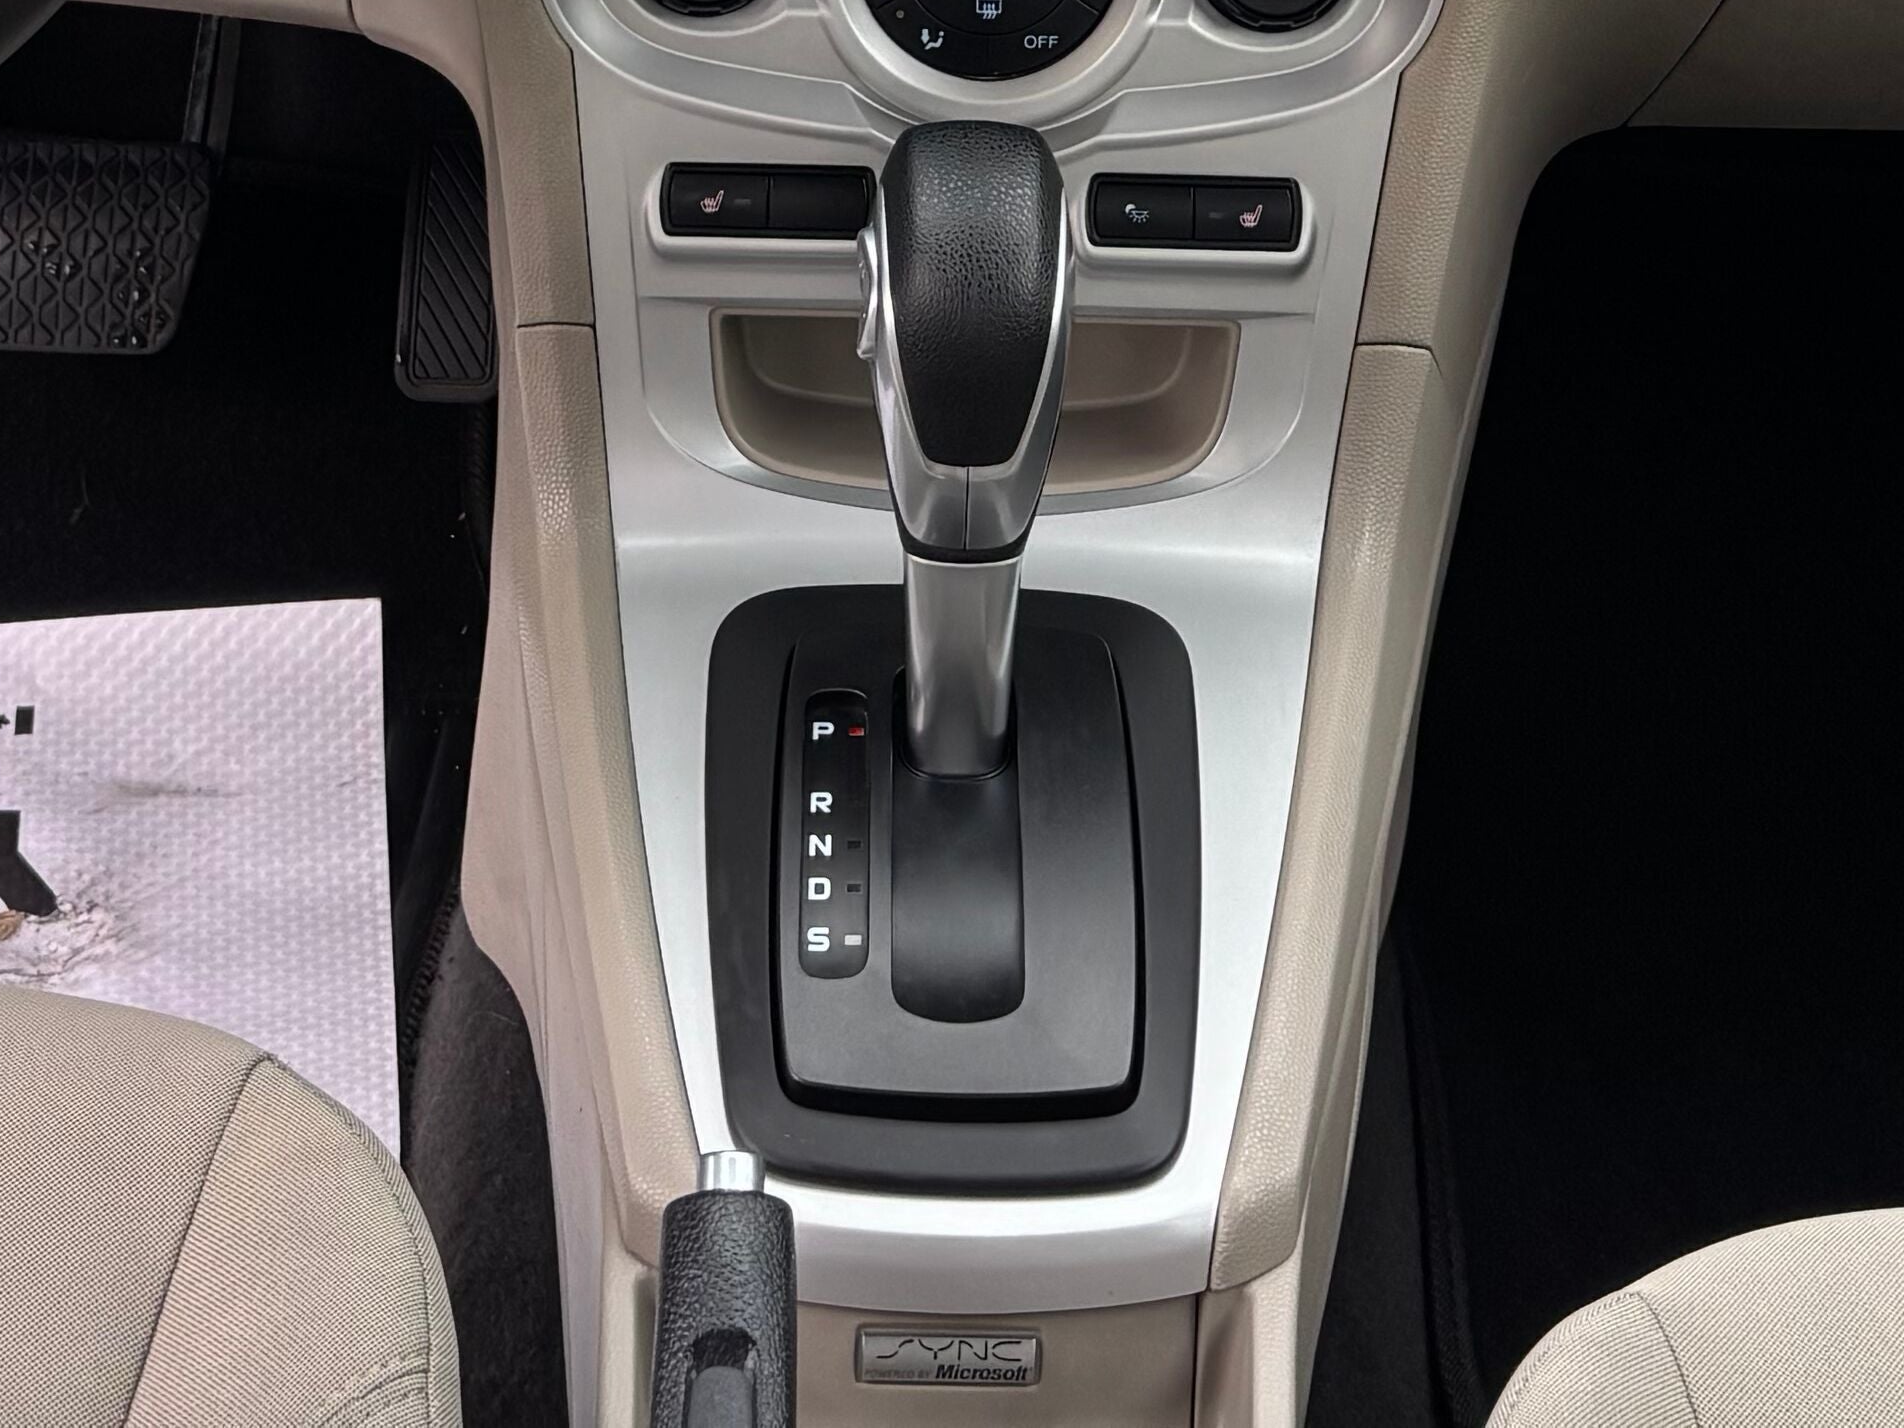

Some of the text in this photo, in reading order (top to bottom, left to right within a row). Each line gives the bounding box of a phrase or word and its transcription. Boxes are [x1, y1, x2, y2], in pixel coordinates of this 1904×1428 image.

[1024, 35, 1059, 49] OFF
[811, 721, 835, 741] P
[809, 791, 833, 814] R
[808, 834, 833, 857] N
[807, 876, 832, 901] D
[806, 927, 831, 952] S
[876, 1337, 1023, 1362] SYNC
[935, 1364, 1030, 1382] Microsoft
